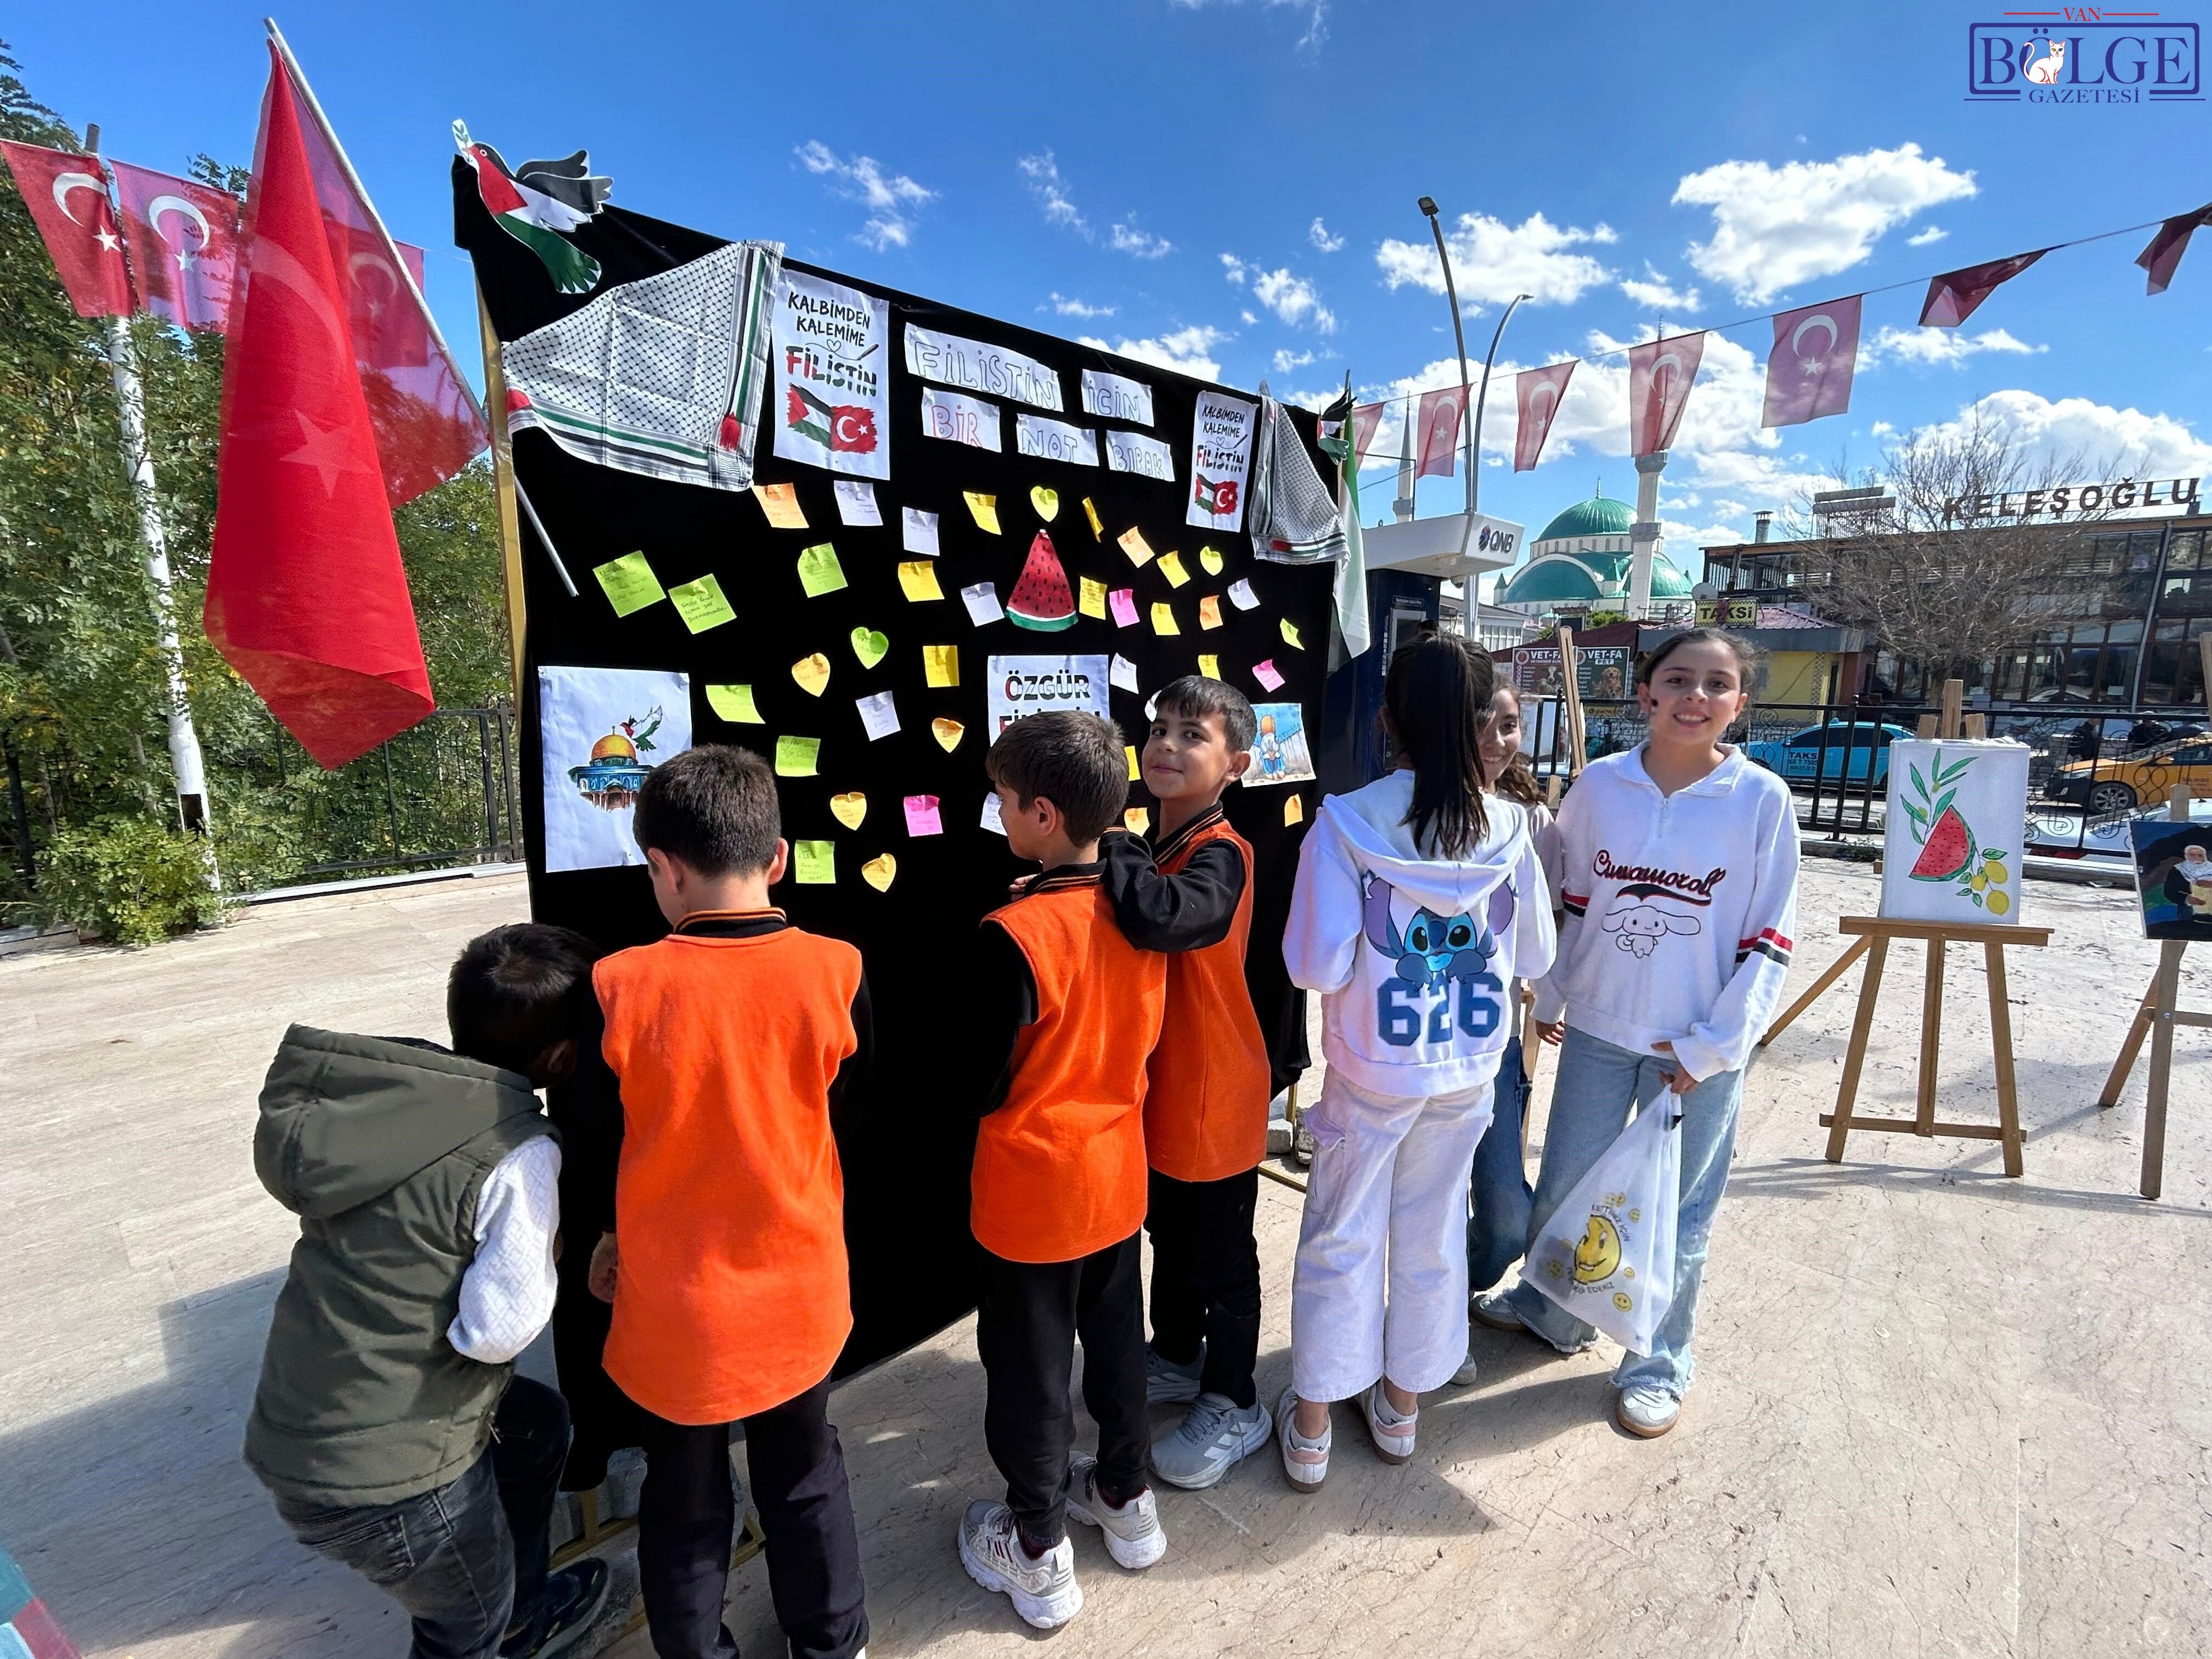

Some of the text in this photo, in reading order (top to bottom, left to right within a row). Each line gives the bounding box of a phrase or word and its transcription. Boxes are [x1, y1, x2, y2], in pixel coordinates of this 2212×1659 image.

[788, 291, 871, 329] KALBİMDEN
[797, 315, 866, 347] KALEMİME
[786, 346, 877, 397] FİLİSTİN
[915, 343, 1056, 410] FİLİSTİN
[1202, 404, 1245, 424] KALBİMDEN
[1203, 421, 1240, 438] KALEMİME
[932, 405, 1165, 479] BİR NOT BIRAK
[1196, 445, 1244, 473] FİLİSTİN
[1489, 530, 1514, 554] QNB
[1587, 650, 1622, 659] VET-FA
[1005, 669, 1091, 701] ÖZGÜR
[1789, 752, 1818, 760] TAKS
[1377, 972, 1503, 1046] 626
